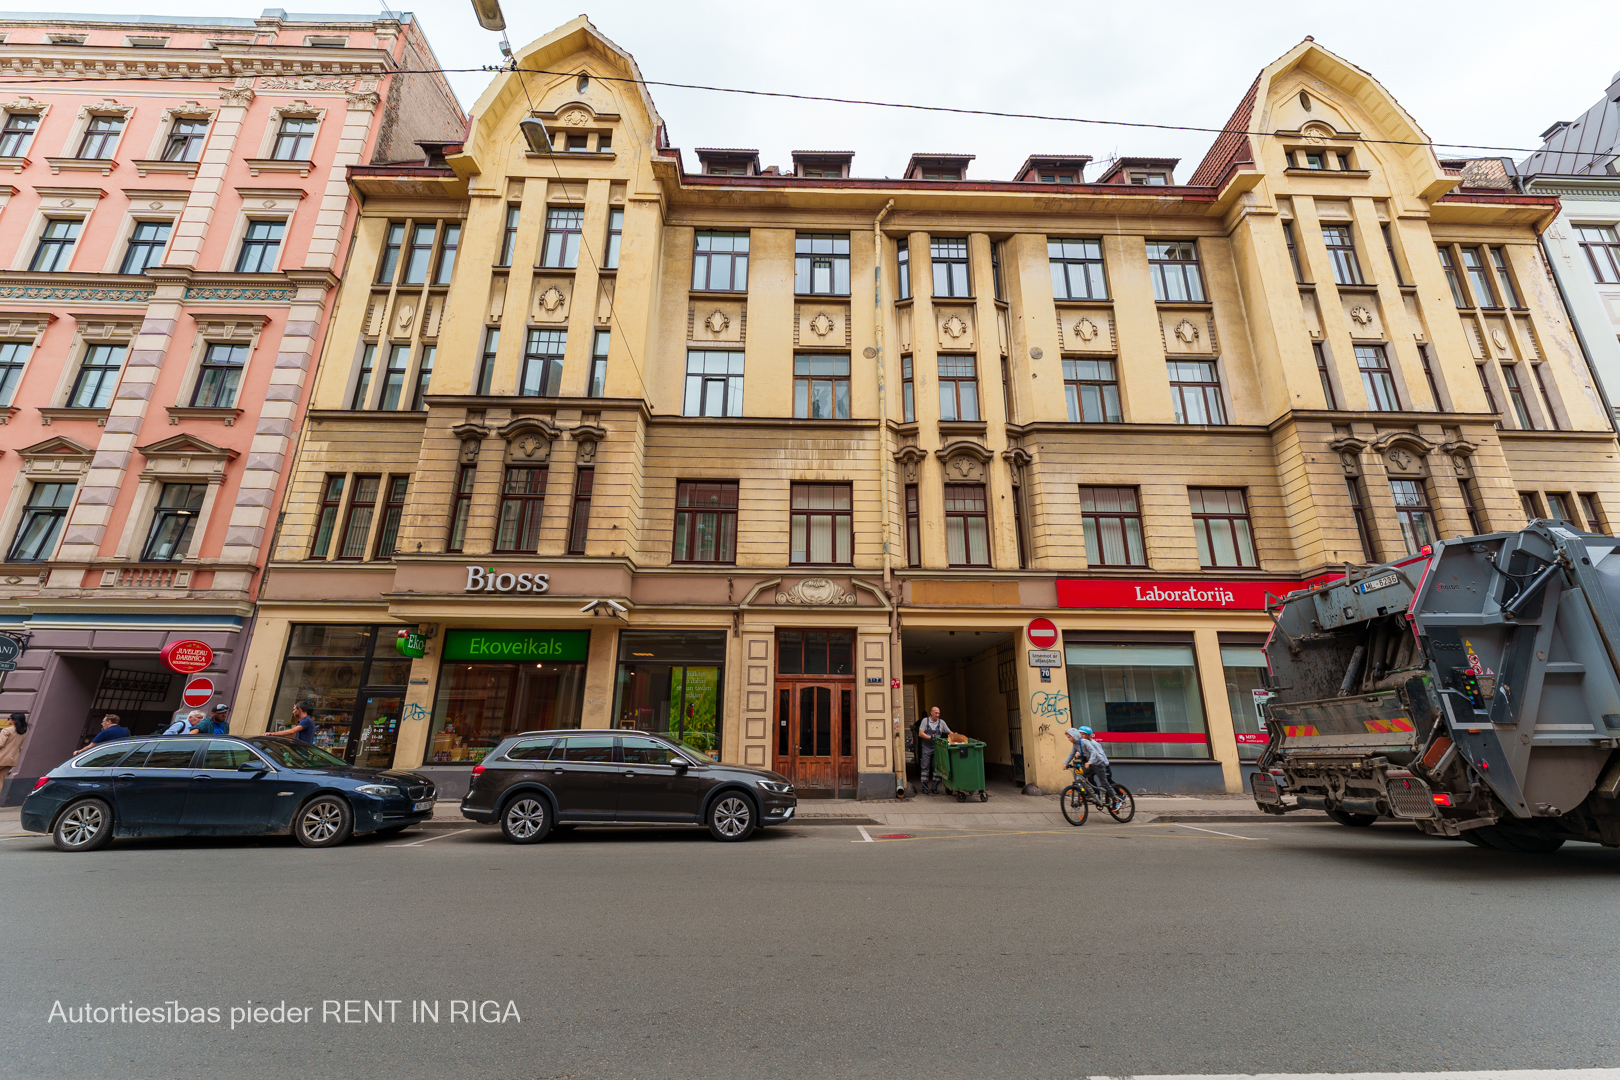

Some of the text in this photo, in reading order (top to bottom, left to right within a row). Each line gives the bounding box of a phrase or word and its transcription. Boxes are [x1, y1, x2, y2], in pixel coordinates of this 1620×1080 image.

[464, 565, 550, 592] Bioss
[1134, 585, 1235, 606] Laboratorija
[469, 637, 563, 655] Ekoveikals
[1041, 669, 1050, 677] 70
